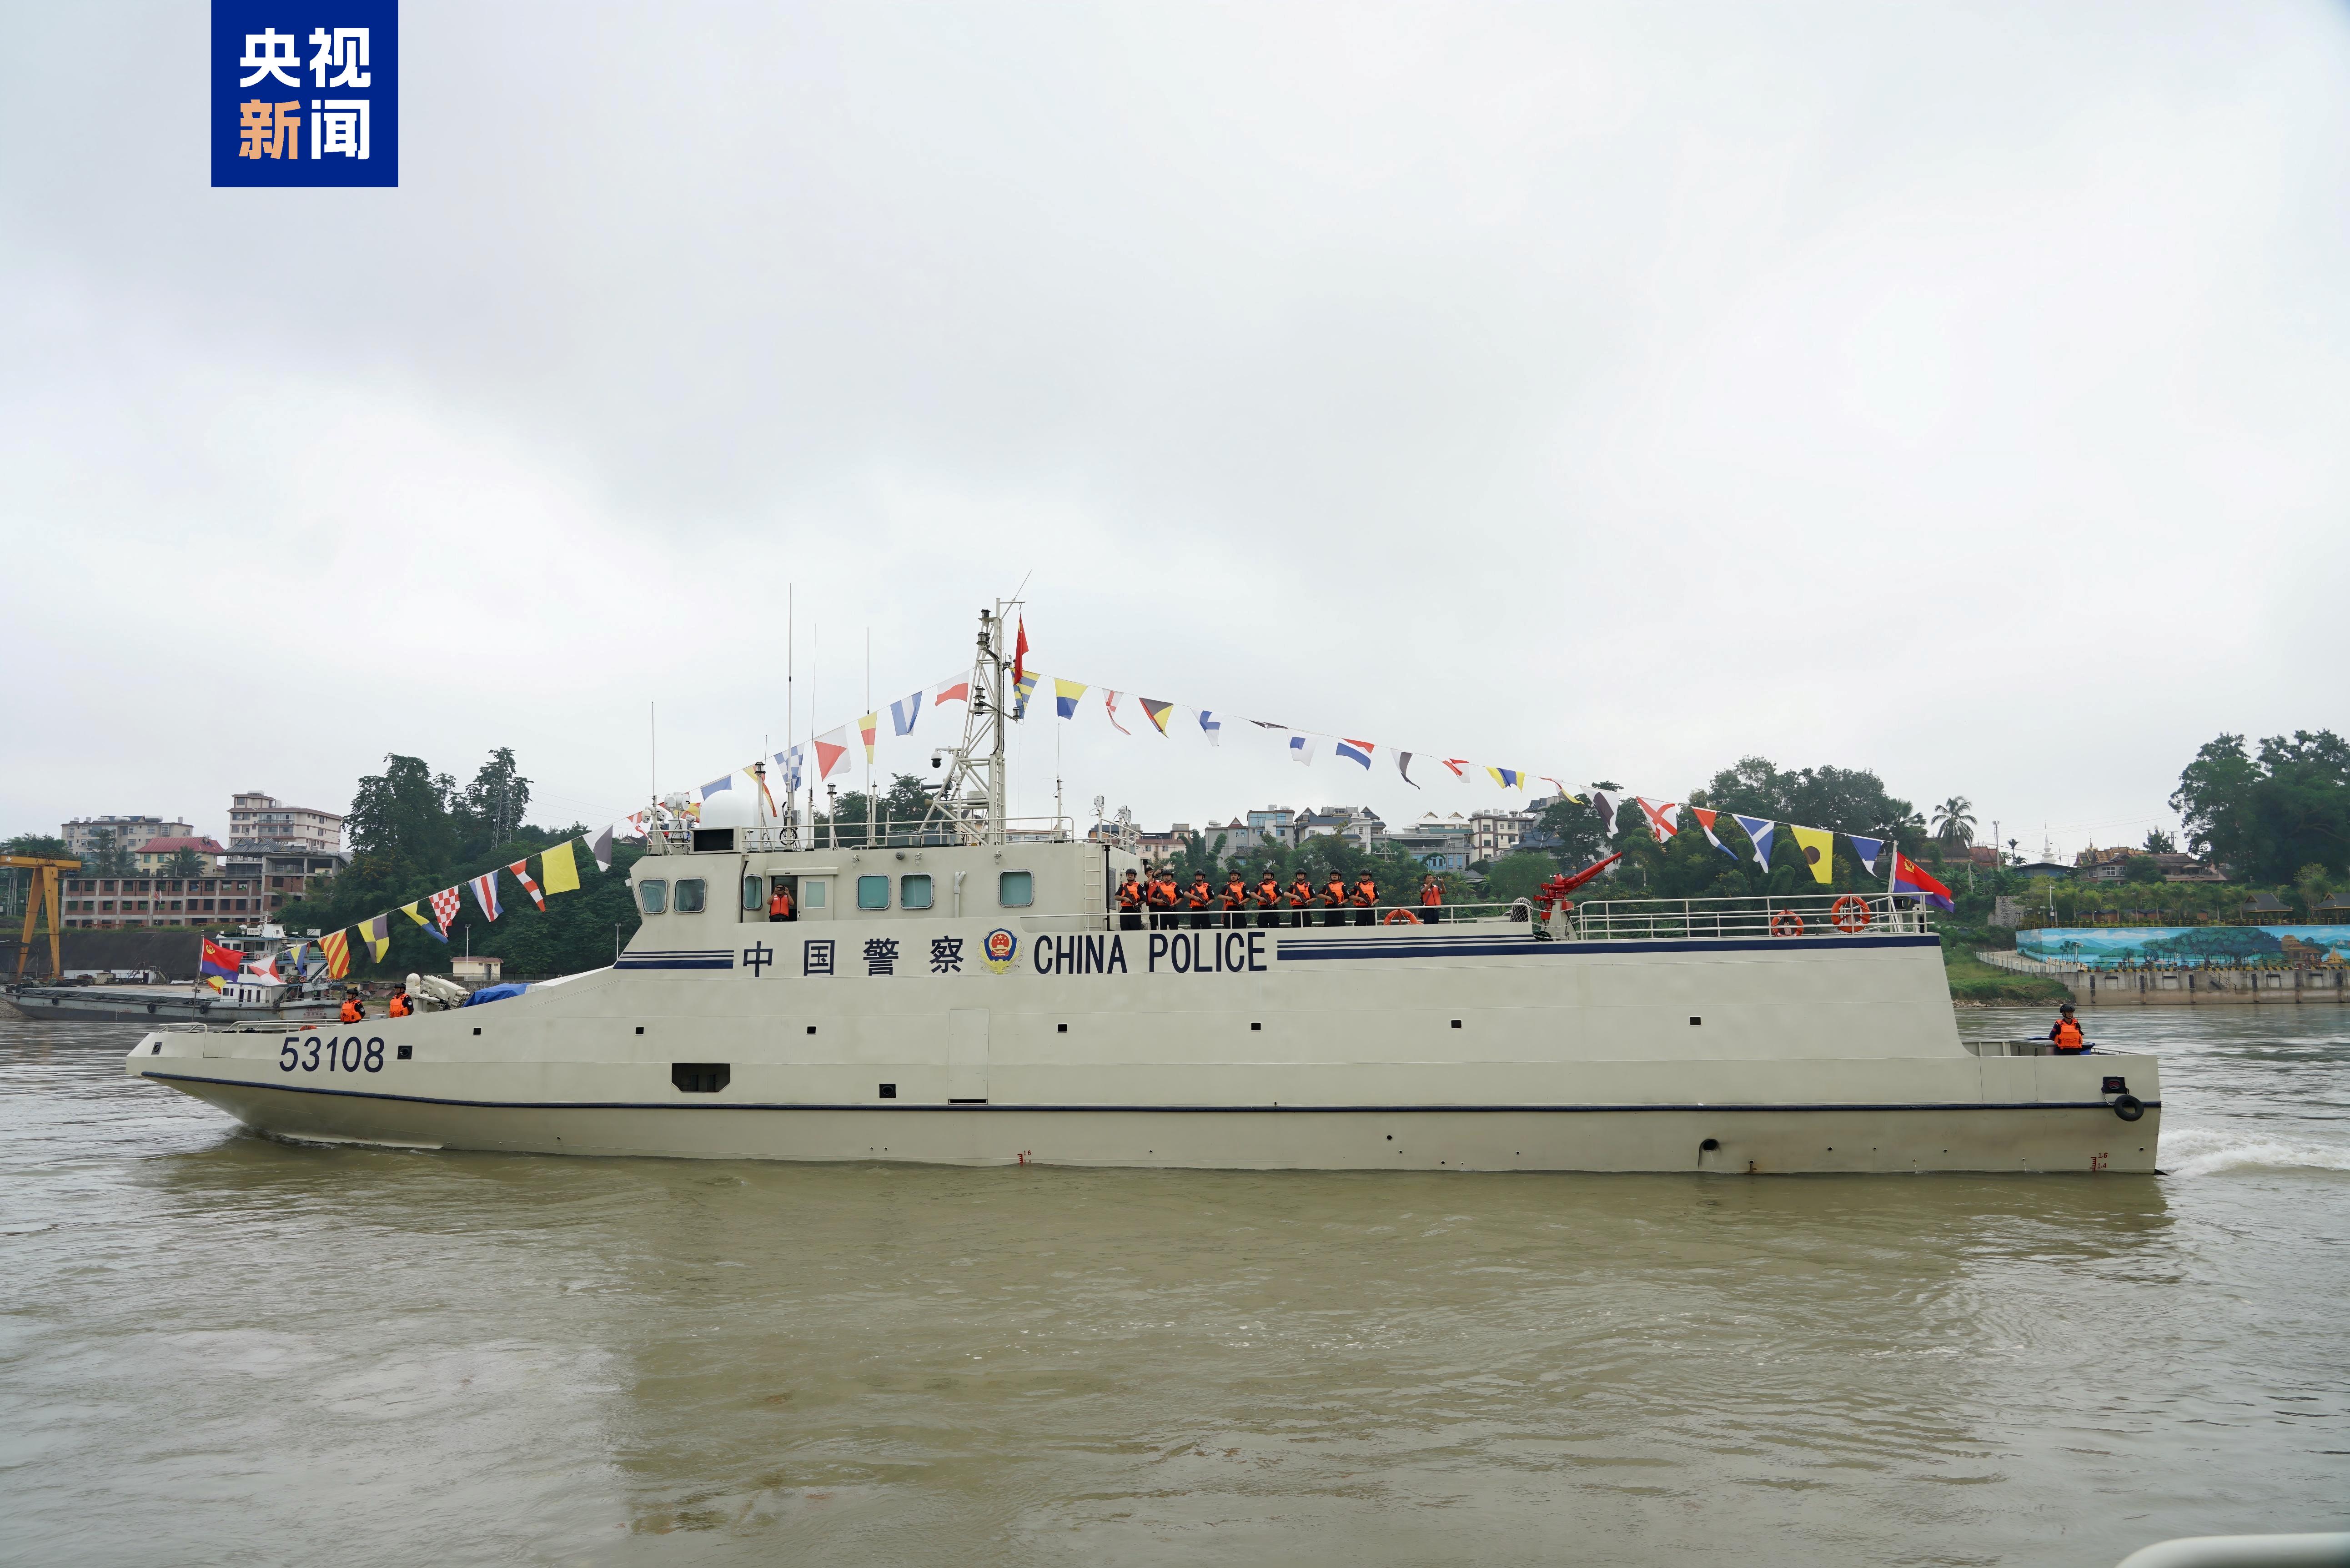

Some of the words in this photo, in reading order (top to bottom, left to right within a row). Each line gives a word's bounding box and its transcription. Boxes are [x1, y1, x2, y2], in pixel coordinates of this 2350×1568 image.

[743, 935, 964, 977] 中国警察
[1034, 935, 1127, 974] CHINA
[1149, 931, 1267, 973] POLICE
[279, 1036, 384, 1072] 53108
